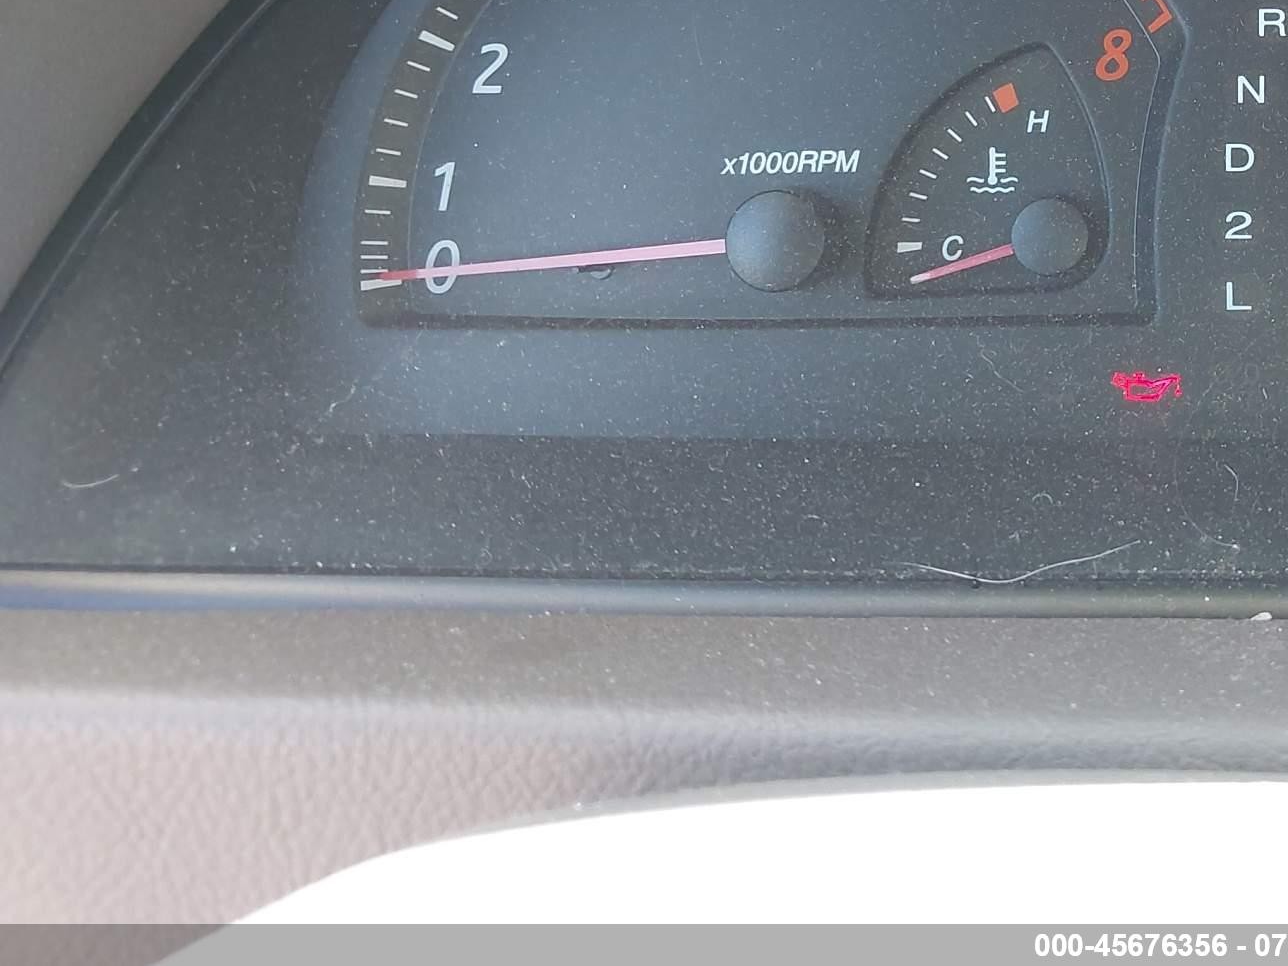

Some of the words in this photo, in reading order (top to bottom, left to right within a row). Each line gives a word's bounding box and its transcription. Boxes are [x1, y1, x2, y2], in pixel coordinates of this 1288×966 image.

[1258, 8, 1286, 37] R
[472, 43, 508, 93] 2
[1095, 29, 1132, 80] 8
[1238, 76, 1265, 103] N
[1027, 110, 1050, 132] H
[721, 150, 860, 175] x1000RPM
[1225, 144, 1254, 171] D
[434, 162, 455, 210] 1
[1226, 212, 1252, 239] 2
[942, 236, 963, 261] C
[425, 240, 460, 293] 0
[1226, 282, 1251, 310] L
